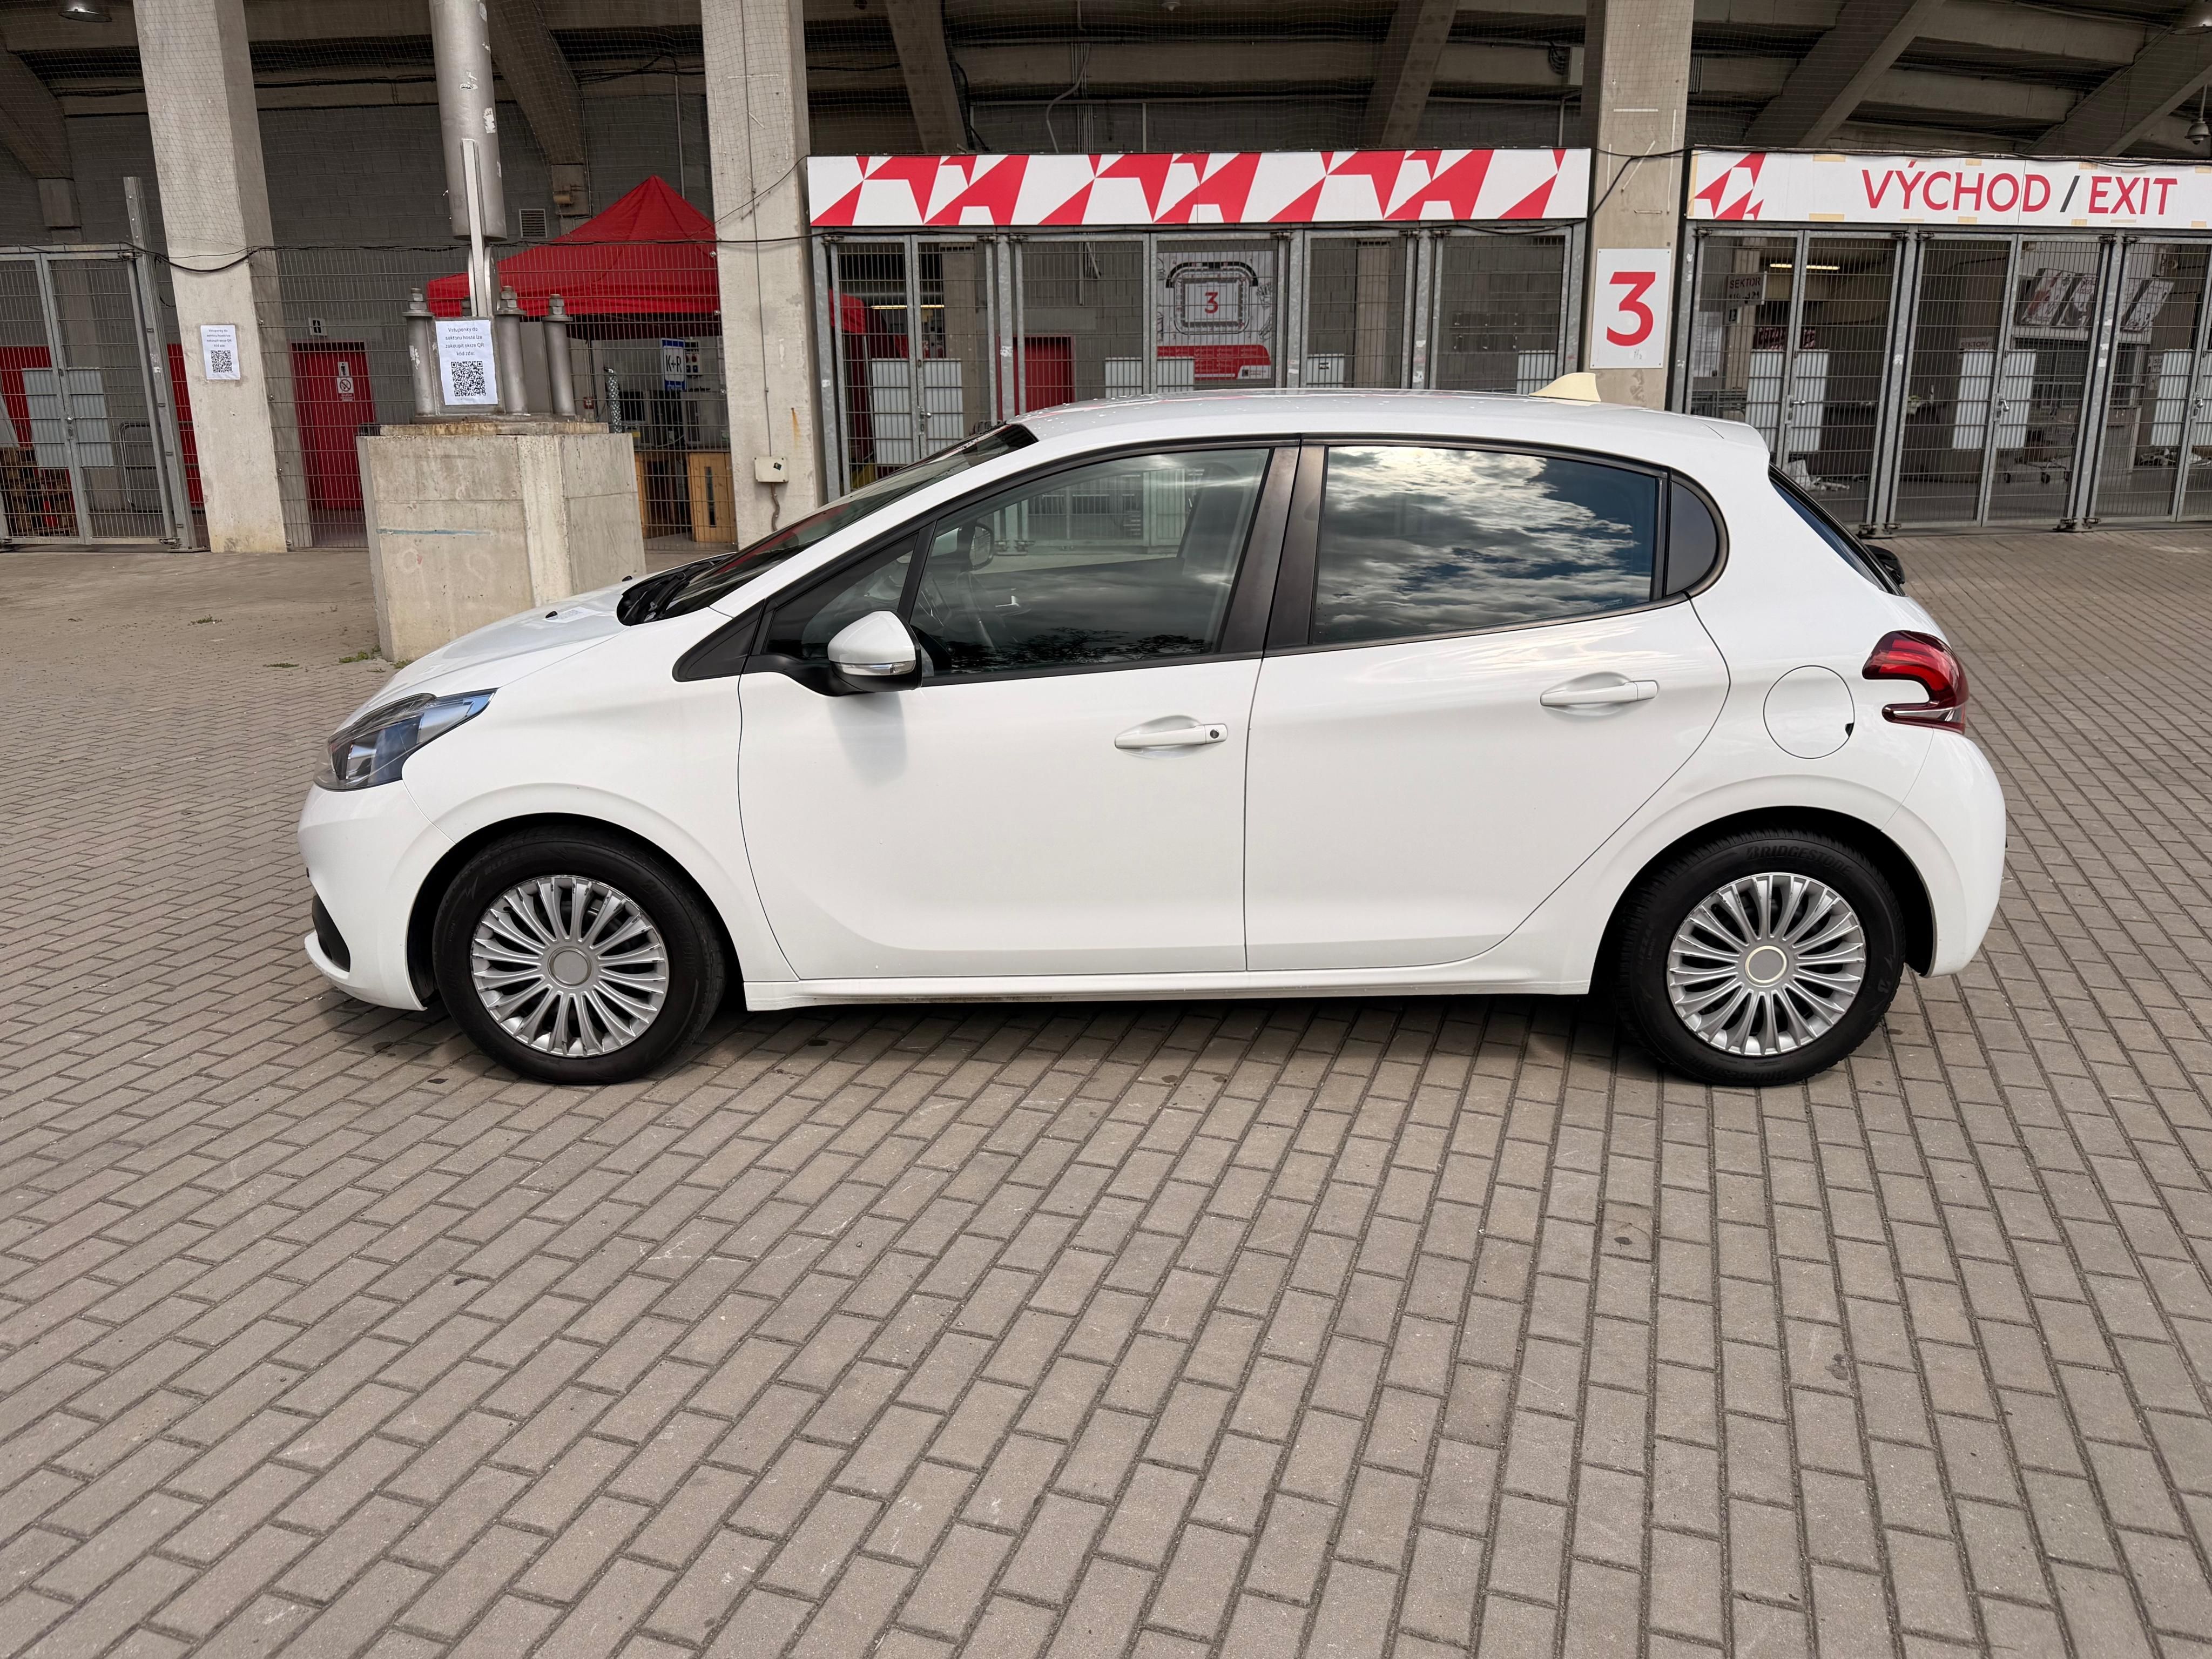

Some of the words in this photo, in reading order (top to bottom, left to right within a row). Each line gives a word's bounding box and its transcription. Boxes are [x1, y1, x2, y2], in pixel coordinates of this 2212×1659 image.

[1861, 159, 2051, 212] VÝCHOD
[2059, 176, 2081, 213] /
[2088, 176, 2178, 215] EXIT
[1204, 292, 1219, 314] 3
[1606, 272, 1656, 346] 3
[1745, 846, 1852, 876] BRIDGESTONE
